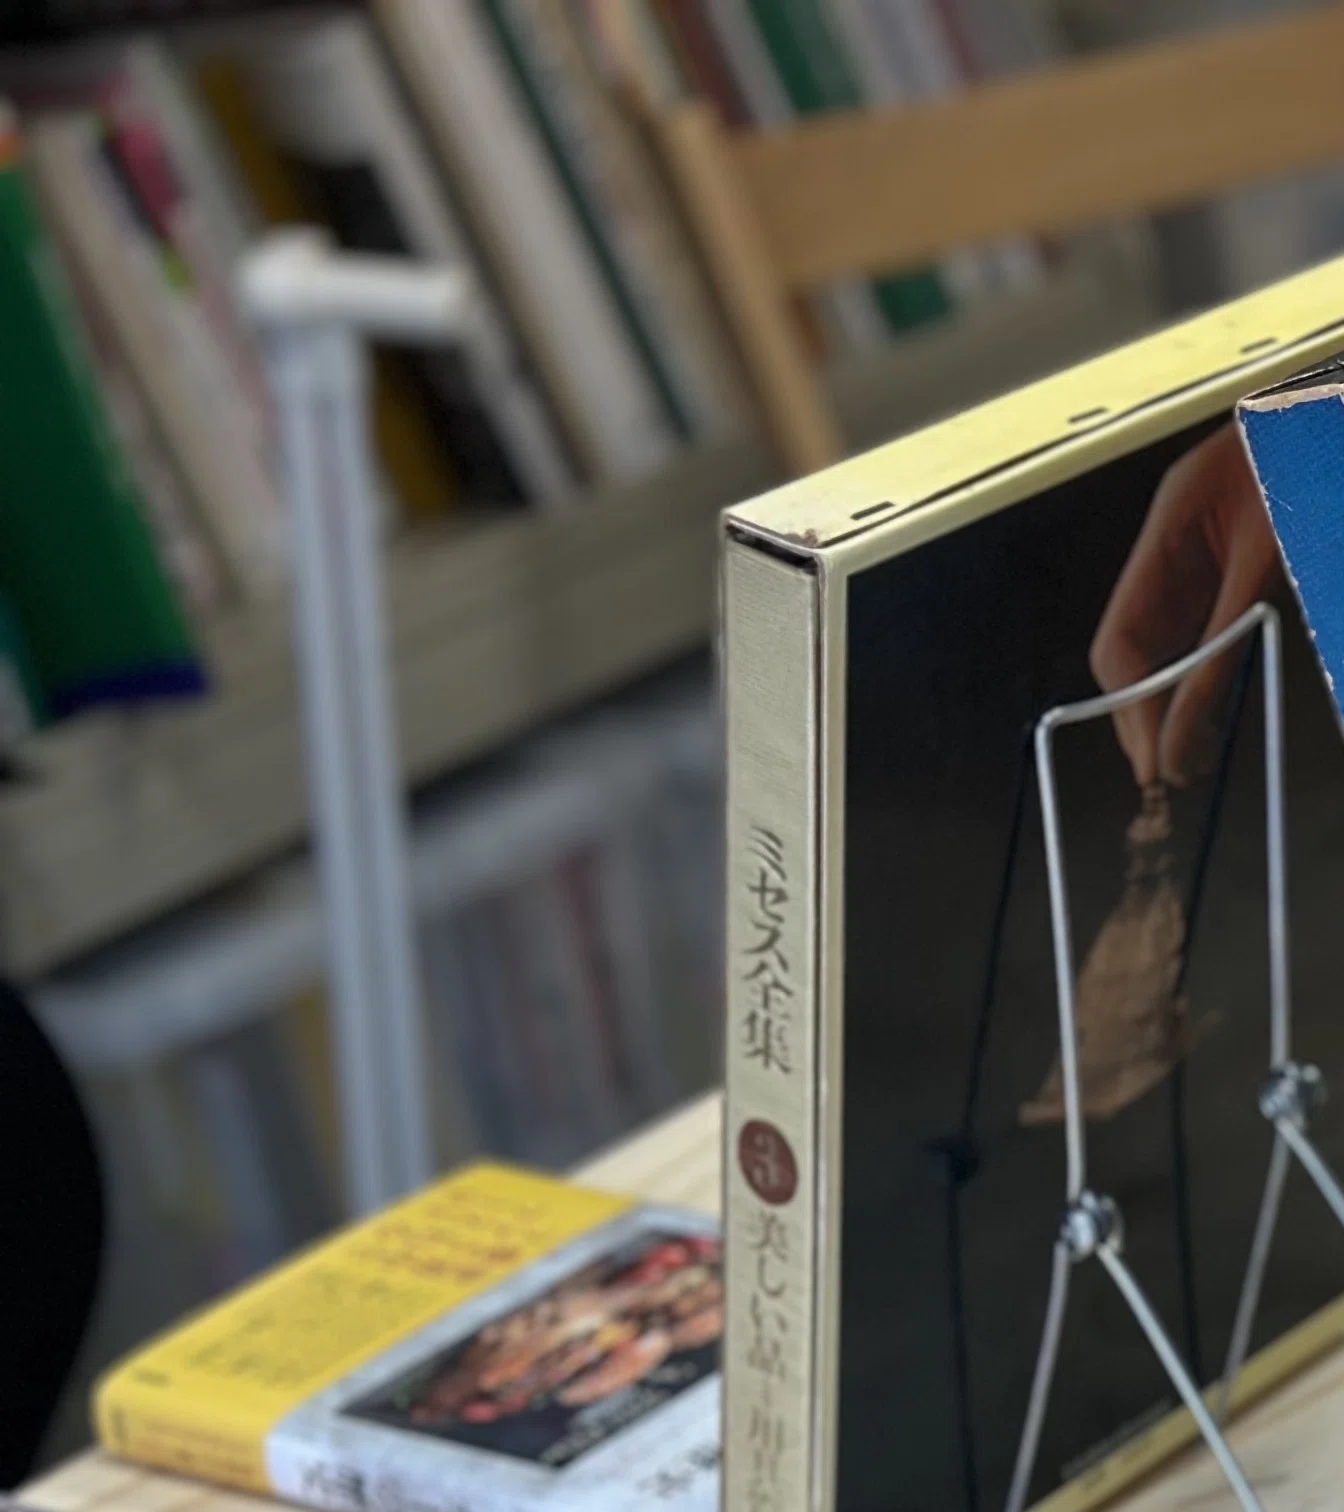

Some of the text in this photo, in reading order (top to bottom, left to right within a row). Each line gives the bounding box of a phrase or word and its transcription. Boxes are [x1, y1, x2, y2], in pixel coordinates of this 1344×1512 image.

[741, 826, 793, 1074] ミセス全集
